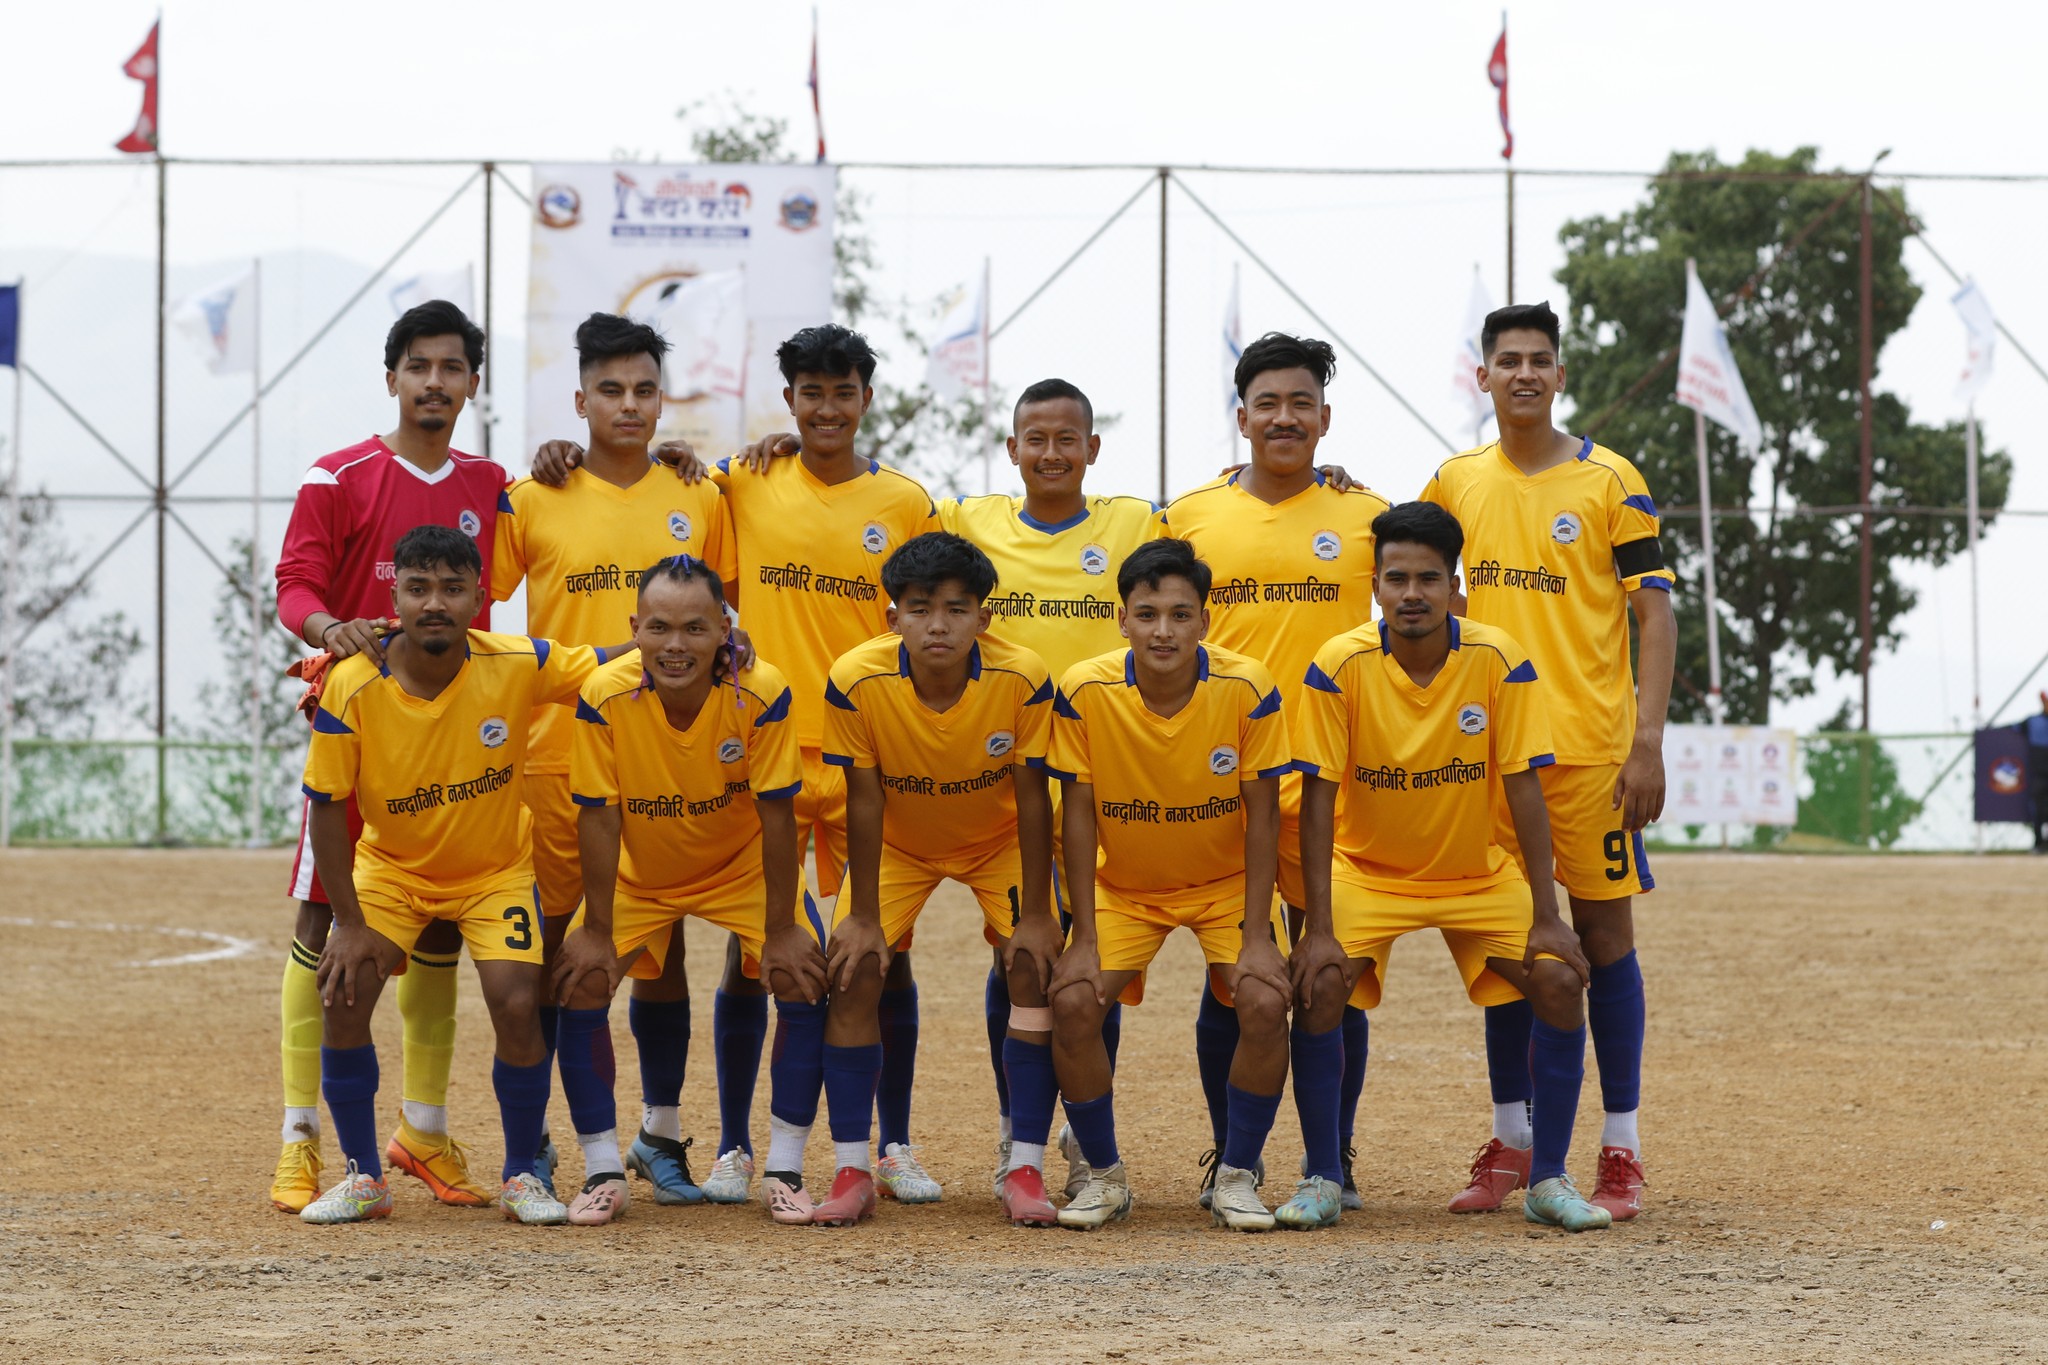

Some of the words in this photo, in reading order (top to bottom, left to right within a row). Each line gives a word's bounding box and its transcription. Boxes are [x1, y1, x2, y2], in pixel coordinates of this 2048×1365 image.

[815, 574, 878, 601] नगरपालिका
[1263, 575, 1340, 603] नगरपालिका
[1470, 560, 1501, 591] द्रागिरि
[1504, 566, 1567, 595] नगरपालिका
[1040, 594, 1114, 619] नगरपालिका
[447, 763, 514, 803] नगरपालिका
[939, 763, 1014, 796] नगरपालिका
[1412, 757, 1486, 790] नगरपालिका
[1165, 795, 1240, 823] नगरपालिका
[1603, 830, 1629, 881] 9
[503, 906, 531, 950] 3
